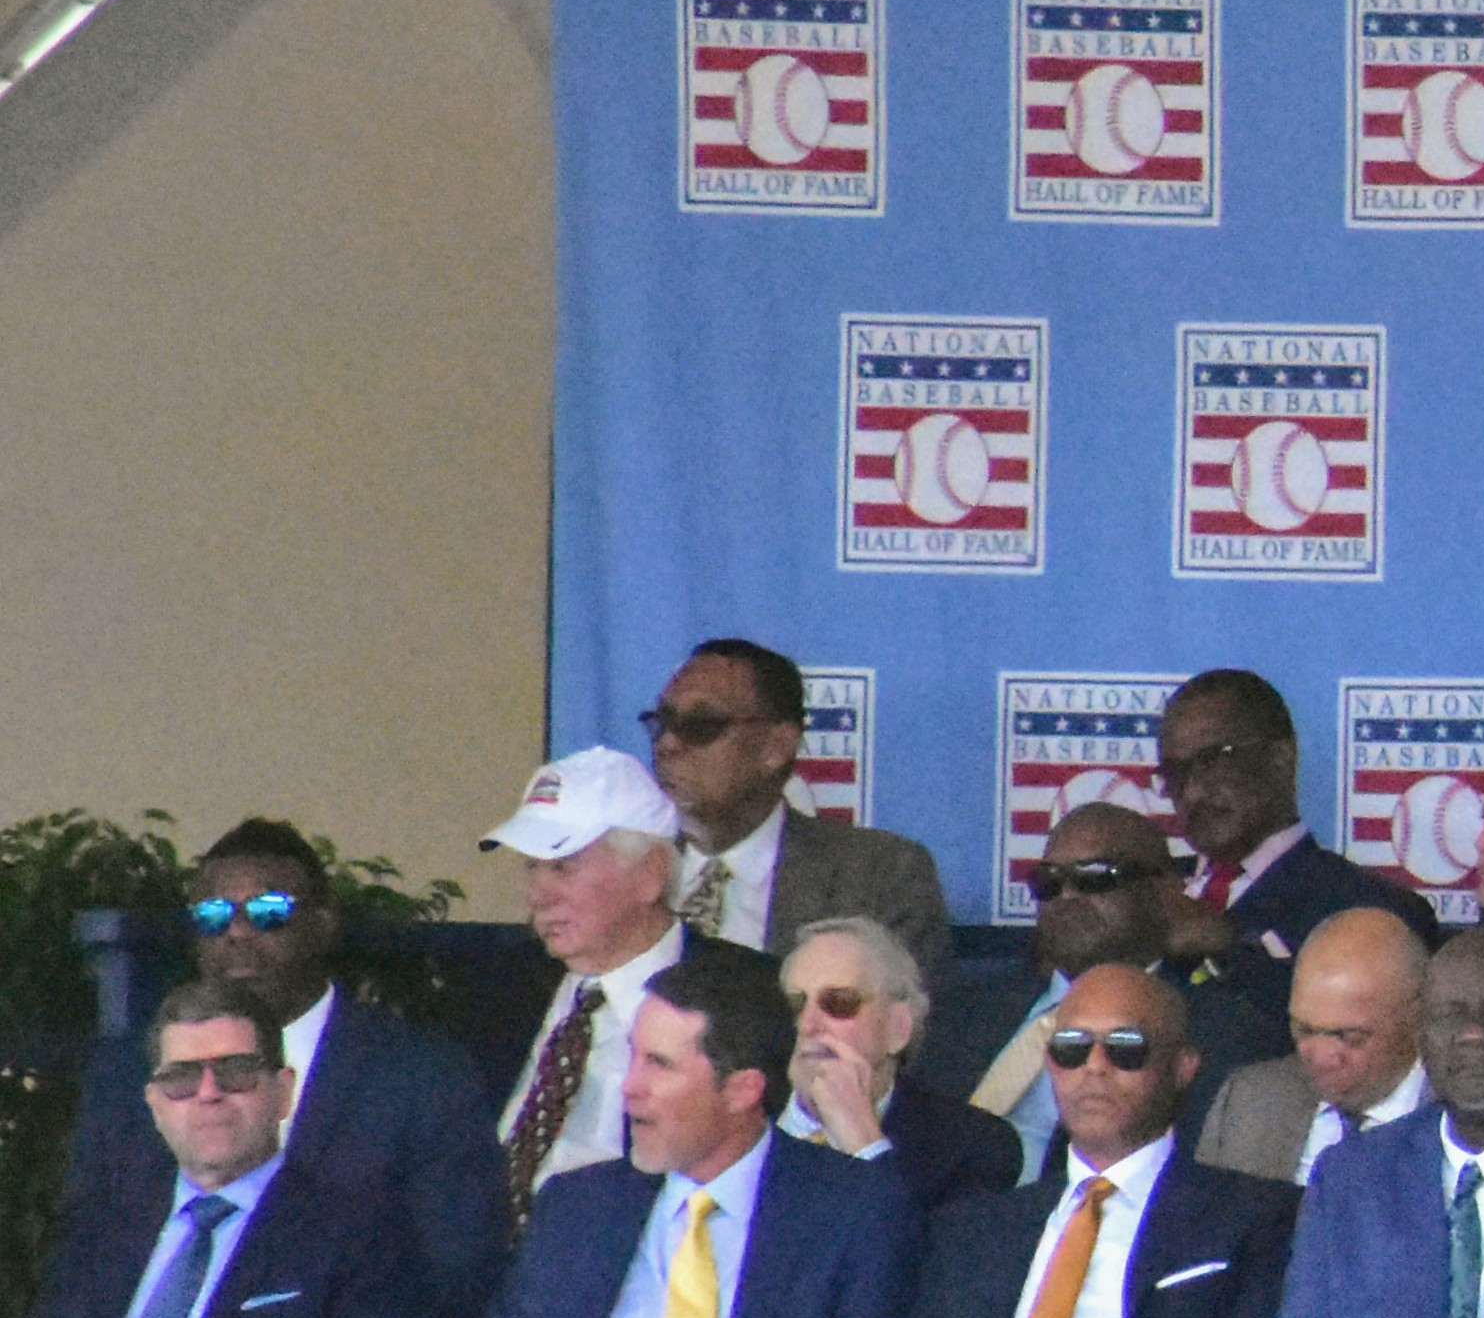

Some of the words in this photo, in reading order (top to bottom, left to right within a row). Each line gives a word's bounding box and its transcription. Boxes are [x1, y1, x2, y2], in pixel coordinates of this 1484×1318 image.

[694, 21, 868, 48] BASEBALL
[1027, 32, 1204, 58] BASEBALL
[693, 171, 757, 194] HALL
[763, 173, 795, 195] OF
[803, 175, 869, 198] FAME
[1024, 181, 1088, 203] HALL
[1095, 183, 1127, 204] OF
[1136, 183, 1203, 206] FAME
[1361, 189, 1425, 210] HALL
[1431, 189, 1464, 210] OF
[857, 329, 1031, 354] NATIONAL
[1193, 338, 1369, 362] NATIONAL
[856, 382, 1031, 406] BASEBALL
[1192, 390, 1369, 414] BASEBALL
[852, 531, 915, 553] HALL
[921, 532, 954, 554] OF
[962, 533, 1028, 555] FAME
[1189, 538, 1253, 560] HALL
[1259, 539, 1292, 561] OF
[1300, 540, 1367, 562] FAME
[1013, 738, 1144, 763] BASEBA
